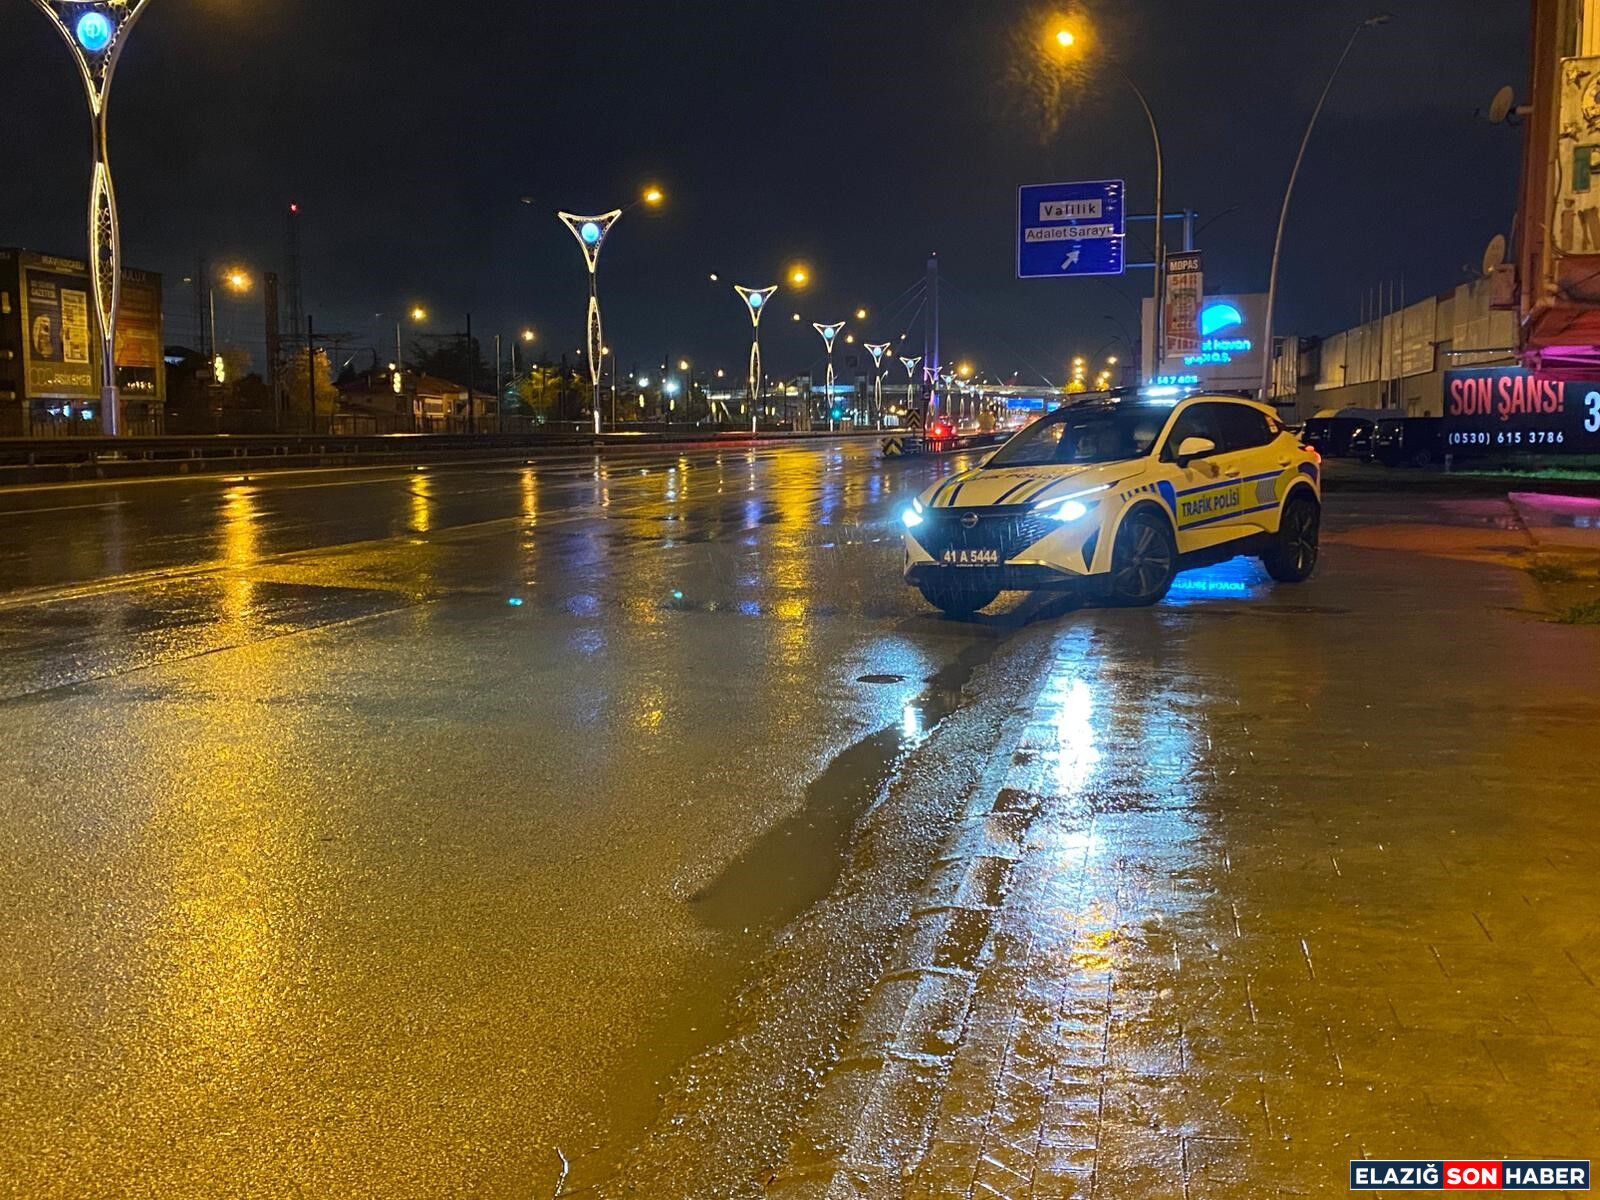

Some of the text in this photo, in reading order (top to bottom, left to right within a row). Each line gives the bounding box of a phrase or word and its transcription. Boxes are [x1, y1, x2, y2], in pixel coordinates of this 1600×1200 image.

[1044, 203, 1096, 216] Valilik
[1026, 228, 1067, 240] Adalet
[1450, 375, 1565, 421] SON ŞANS!
[1448, 432, 1564, 445] (0530) 615 3786
[1181, 488, 1240, 517] TRAFİK POLİSİ
[943, 550, 998, 563] 41 A 5444
